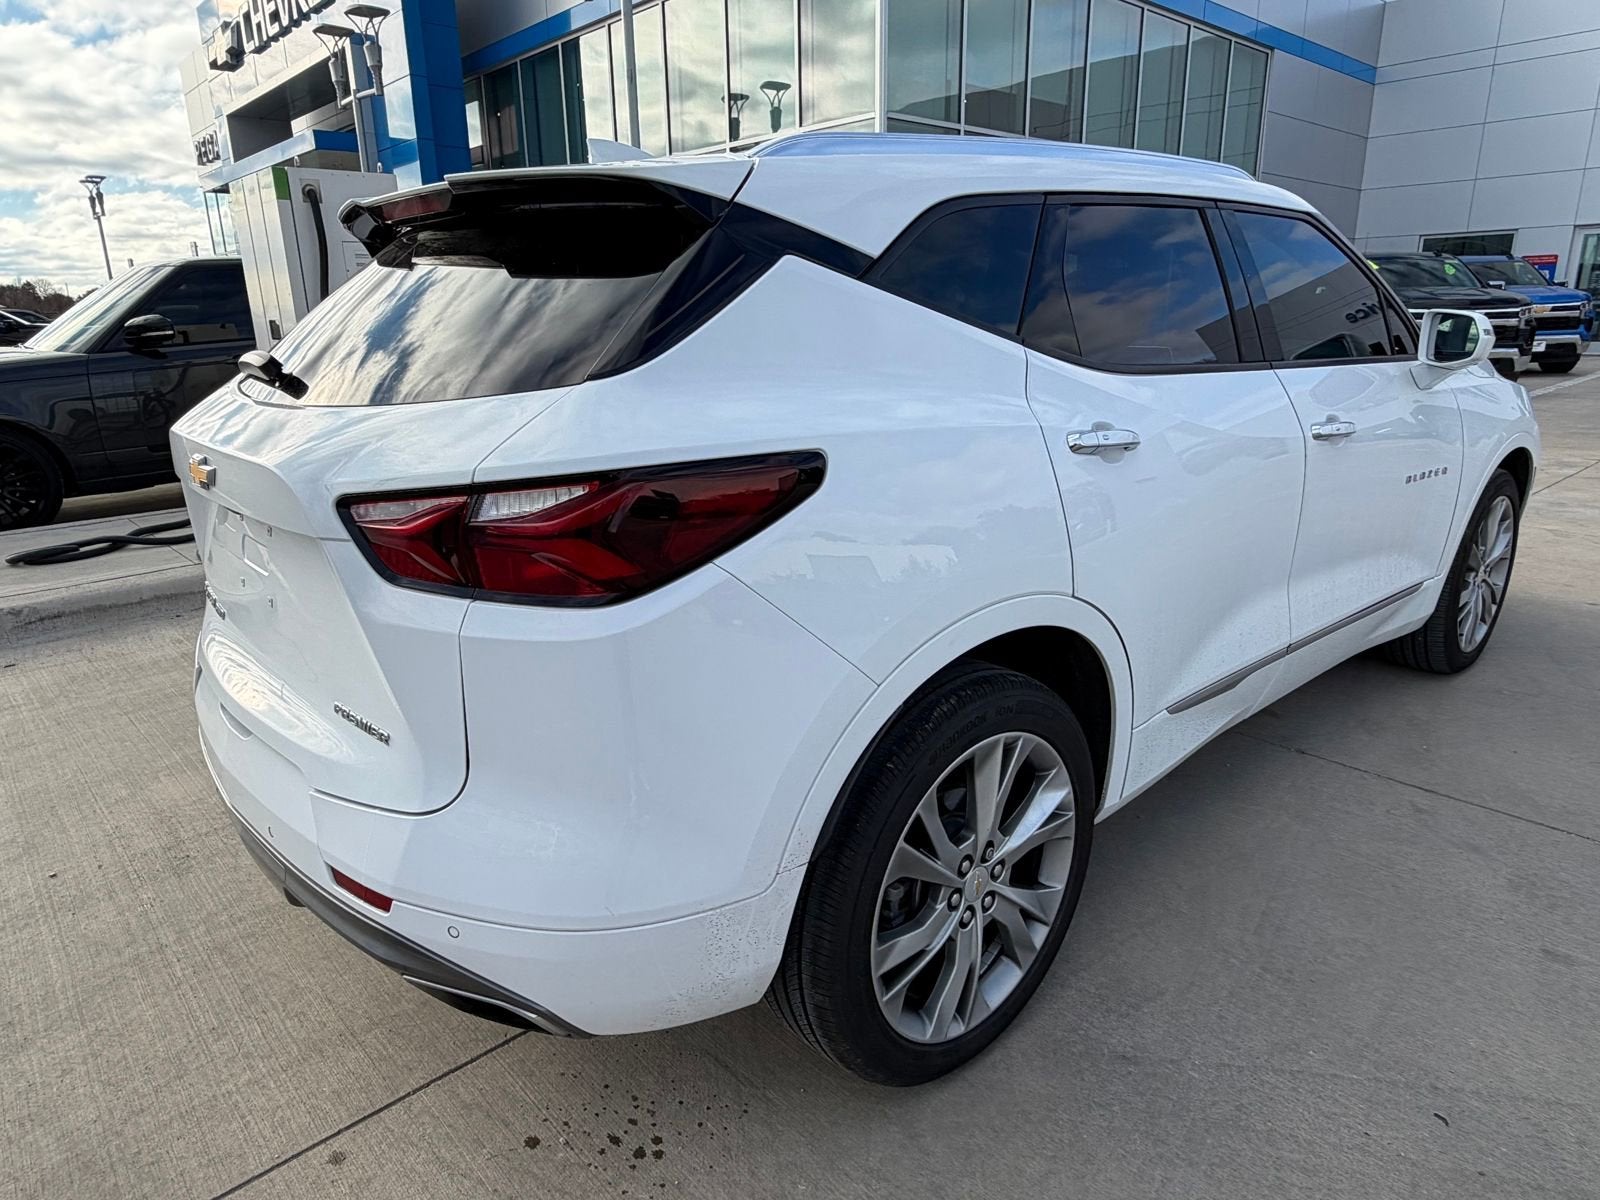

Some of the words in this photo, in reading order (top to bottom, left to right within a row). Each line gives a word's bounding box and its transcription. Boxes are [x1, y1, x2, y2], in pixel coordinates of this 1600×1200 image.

[239, 0, 331, 51] CHEV
[1405, 466, 1448, 485] BLAZER
[334, 701, 390, 746] PREMIER
